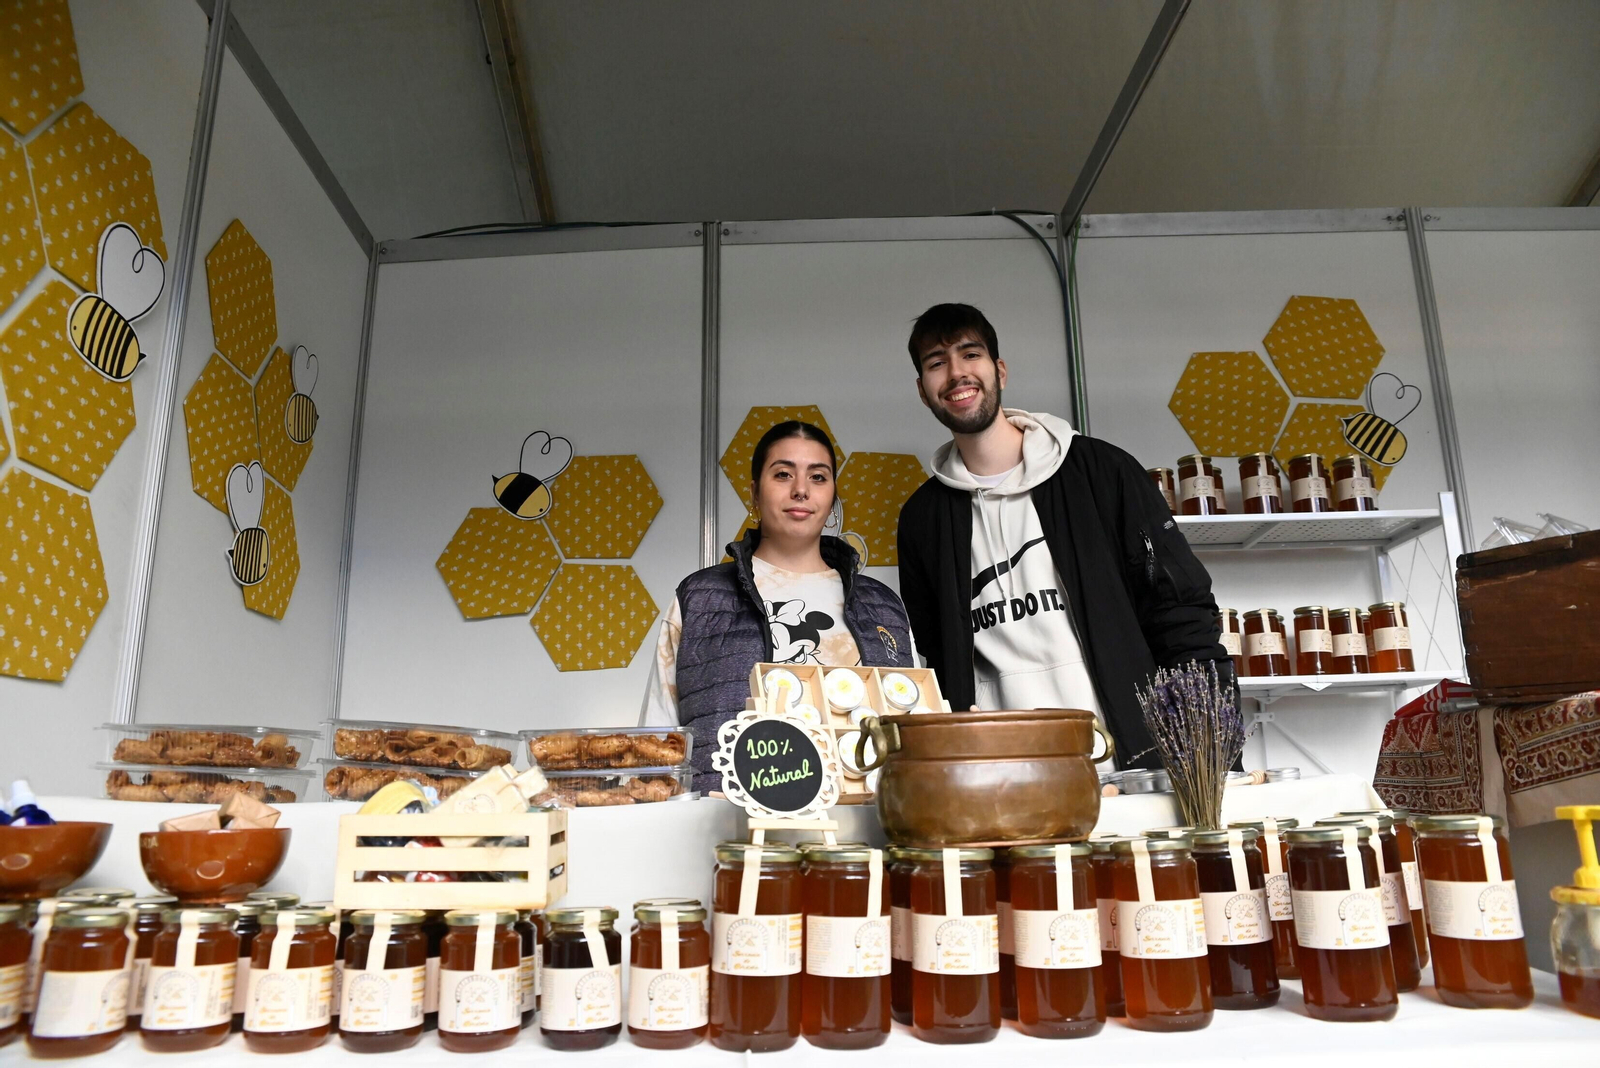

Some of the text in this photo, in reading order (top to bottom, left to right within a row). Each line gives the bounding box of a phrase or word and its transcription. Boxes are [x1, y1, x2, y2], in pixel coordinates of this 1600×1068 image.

[971, 589, 1065, 633] JUST DO IT.
[747, 738, 793, 759] 100%
[750, 758, 814, 791] Natural
